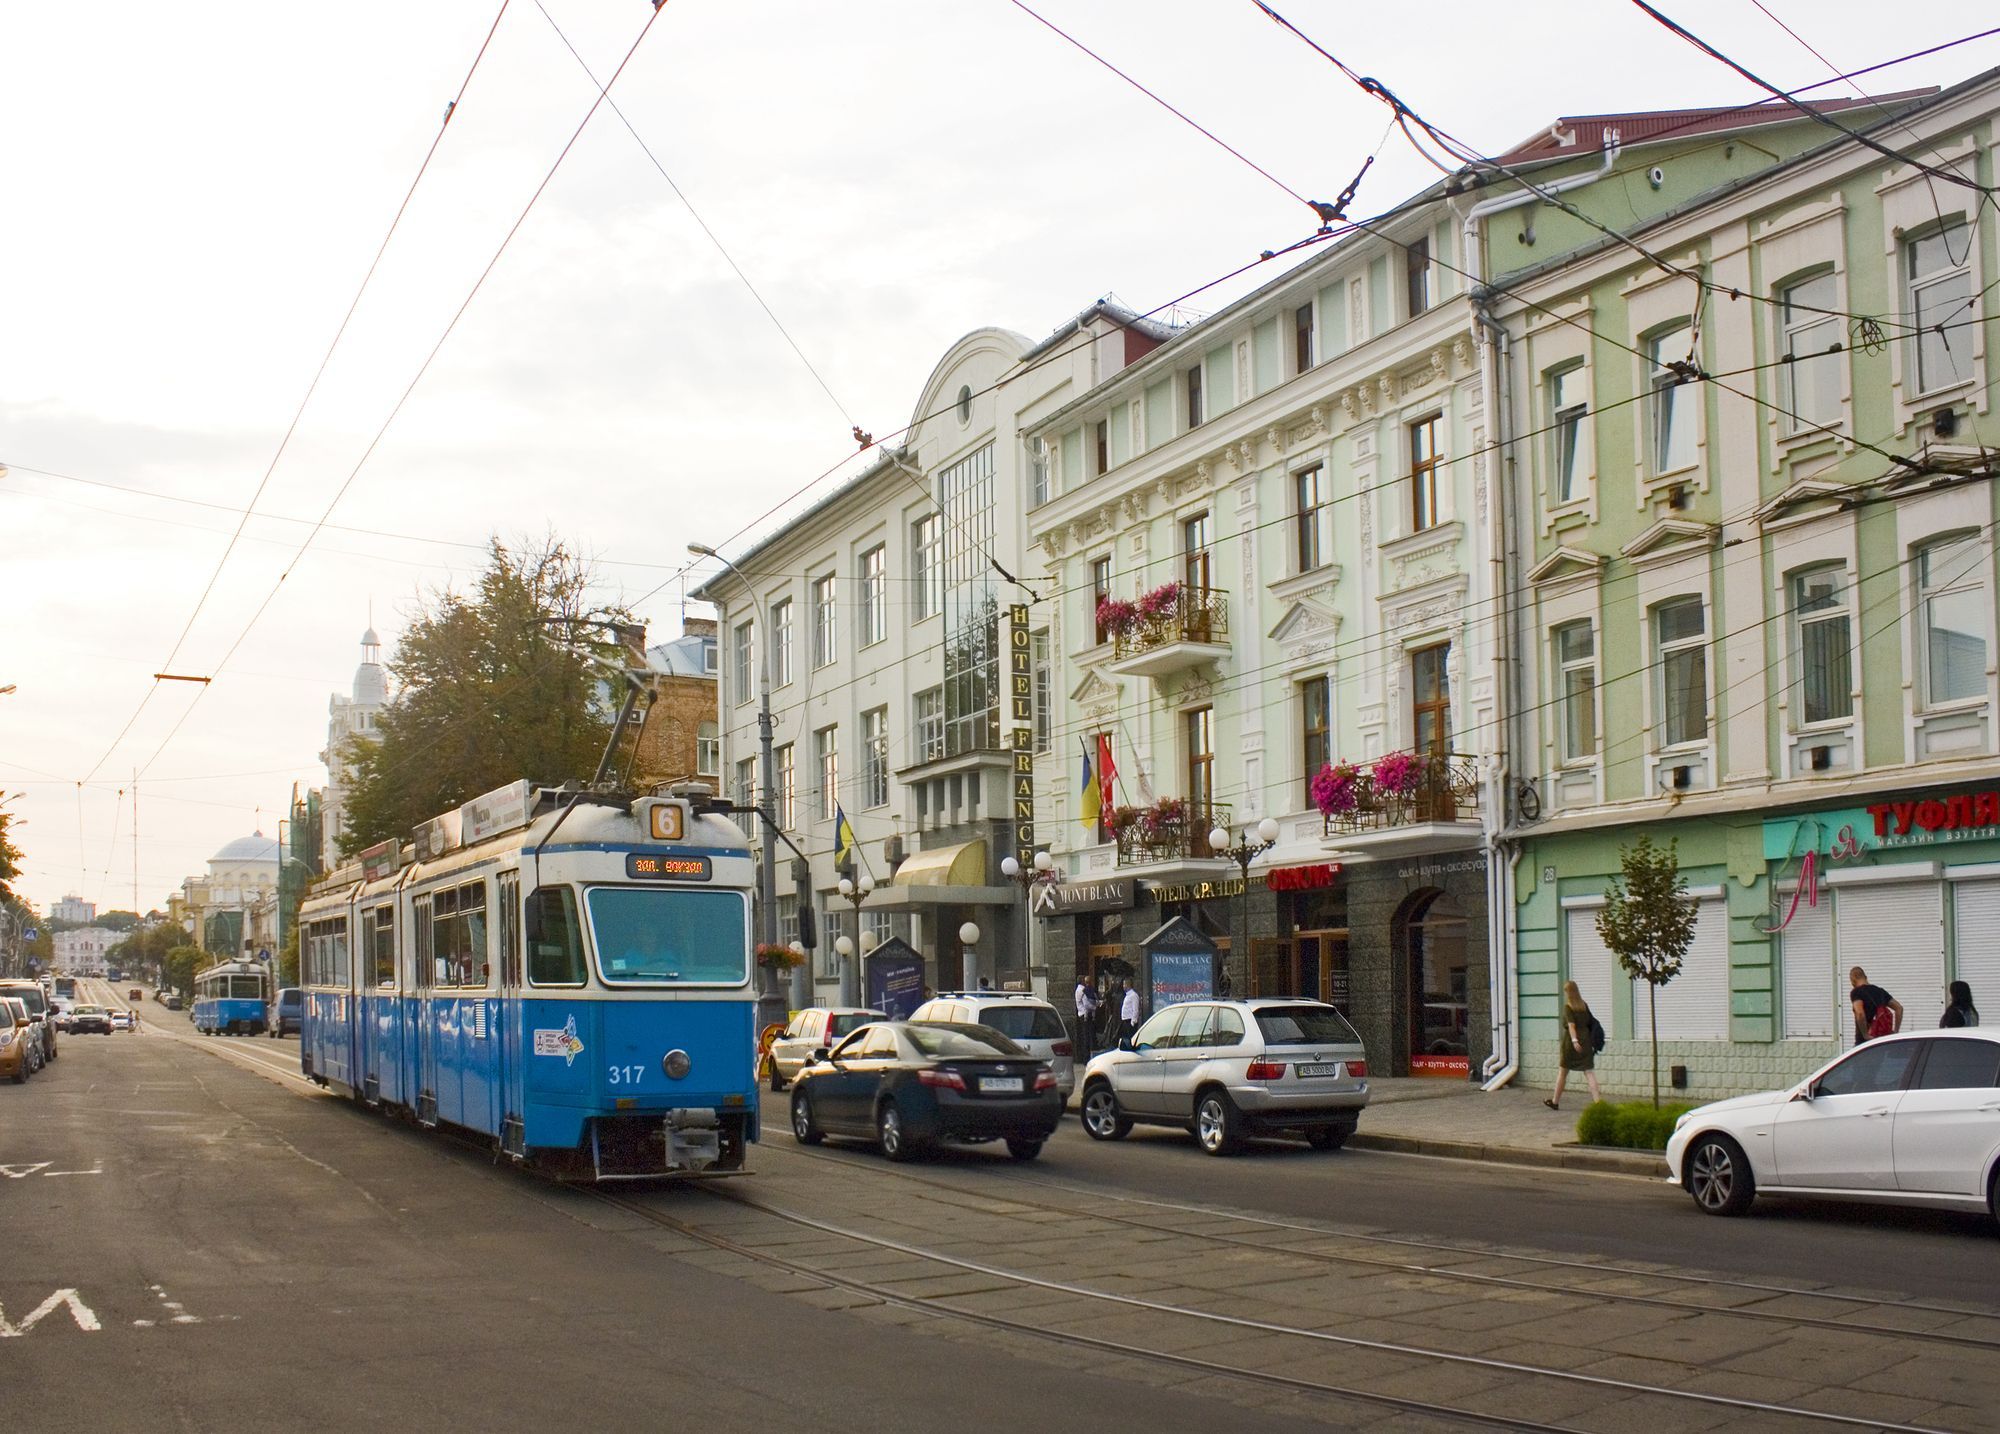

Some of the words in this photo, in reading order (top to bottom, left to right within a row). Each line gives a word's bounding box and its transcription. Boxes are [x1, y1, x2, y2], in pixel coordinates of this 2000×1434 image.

[1013, 608, 1029, 717] HOTEL
[1017, 732, 1032, 865] FRANCE
[658, 807, 675, 835] 6
[1866, 792, 1999, 837] ТУФЛЯ
[1877, 834, 1935, 847] МАГАЗИН
[1946, 827, 1996, 841] ВЗУТТЯ
[1060, 887, 1087, 903] MONT
[1090, 883, 1124, 900] BLANC
[1154, 956, 1179, 965] MONT
[1182, 956, 1212, 965] BLANC
[609, 1065, 645, 1084] 317
